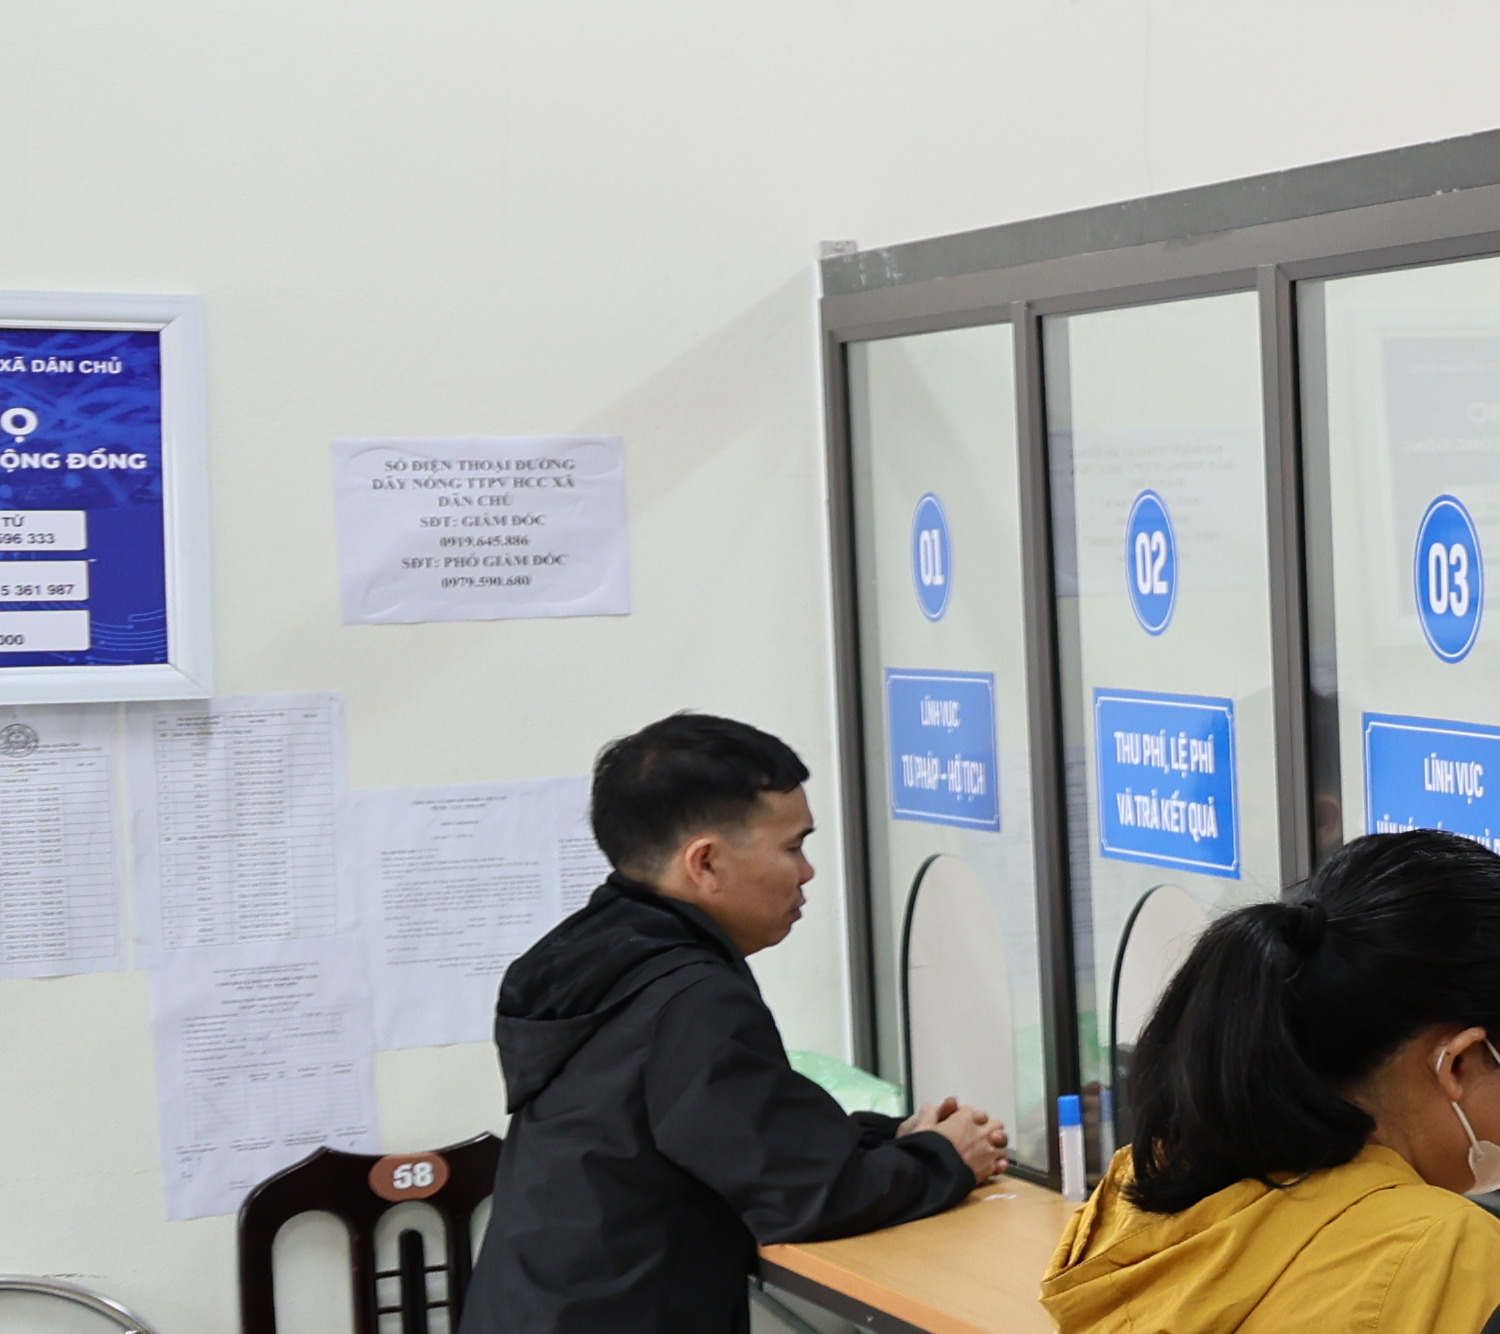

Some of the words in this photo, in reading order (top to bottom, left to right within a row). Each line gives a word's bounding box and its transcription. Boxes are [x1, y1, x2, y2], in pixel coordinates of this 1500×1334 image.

[31, 357, 74, 373] DÂN
[79, 356, 122, 374] CHỦ
[513, 477, 547, 489] HCC
[27, 533, 56, 545] 333
[920, 529, 944, 585] 01
[1136, 531, 1168, 594] 02
[15, 584, 40, 597] 361
[47, 583, 75, 596] 987
[1429, 543, 1469, 617] 03
[920, 695, 940, 727] LĨNH
[940, 700, 961, 733] VỰC
[915, 750, 939, 790] PHÁP
[947, 753, 961, 801] HỘ
[961, 759, 986, 801] TỊCH
[1113, 731, 1142, 765] THU
[1142, 729, 1171, 774] PHÍ,
[1170, 731, 1189, 778] LỆ
[1189, 734, 1216, 774] PHÍ
[1423, 752, 1455, 794] LĨNH
[1456, 757, 1485, 805] VỰC
[1116, 787, 1136, 827] VÀ
[1134, 788, 1161, 830] TRẢ
[1160, 789, 1188, 834] KẾT
[1188, 796, 1219, 843] QUẢ
[392, 1161, 433, 1189] 58
